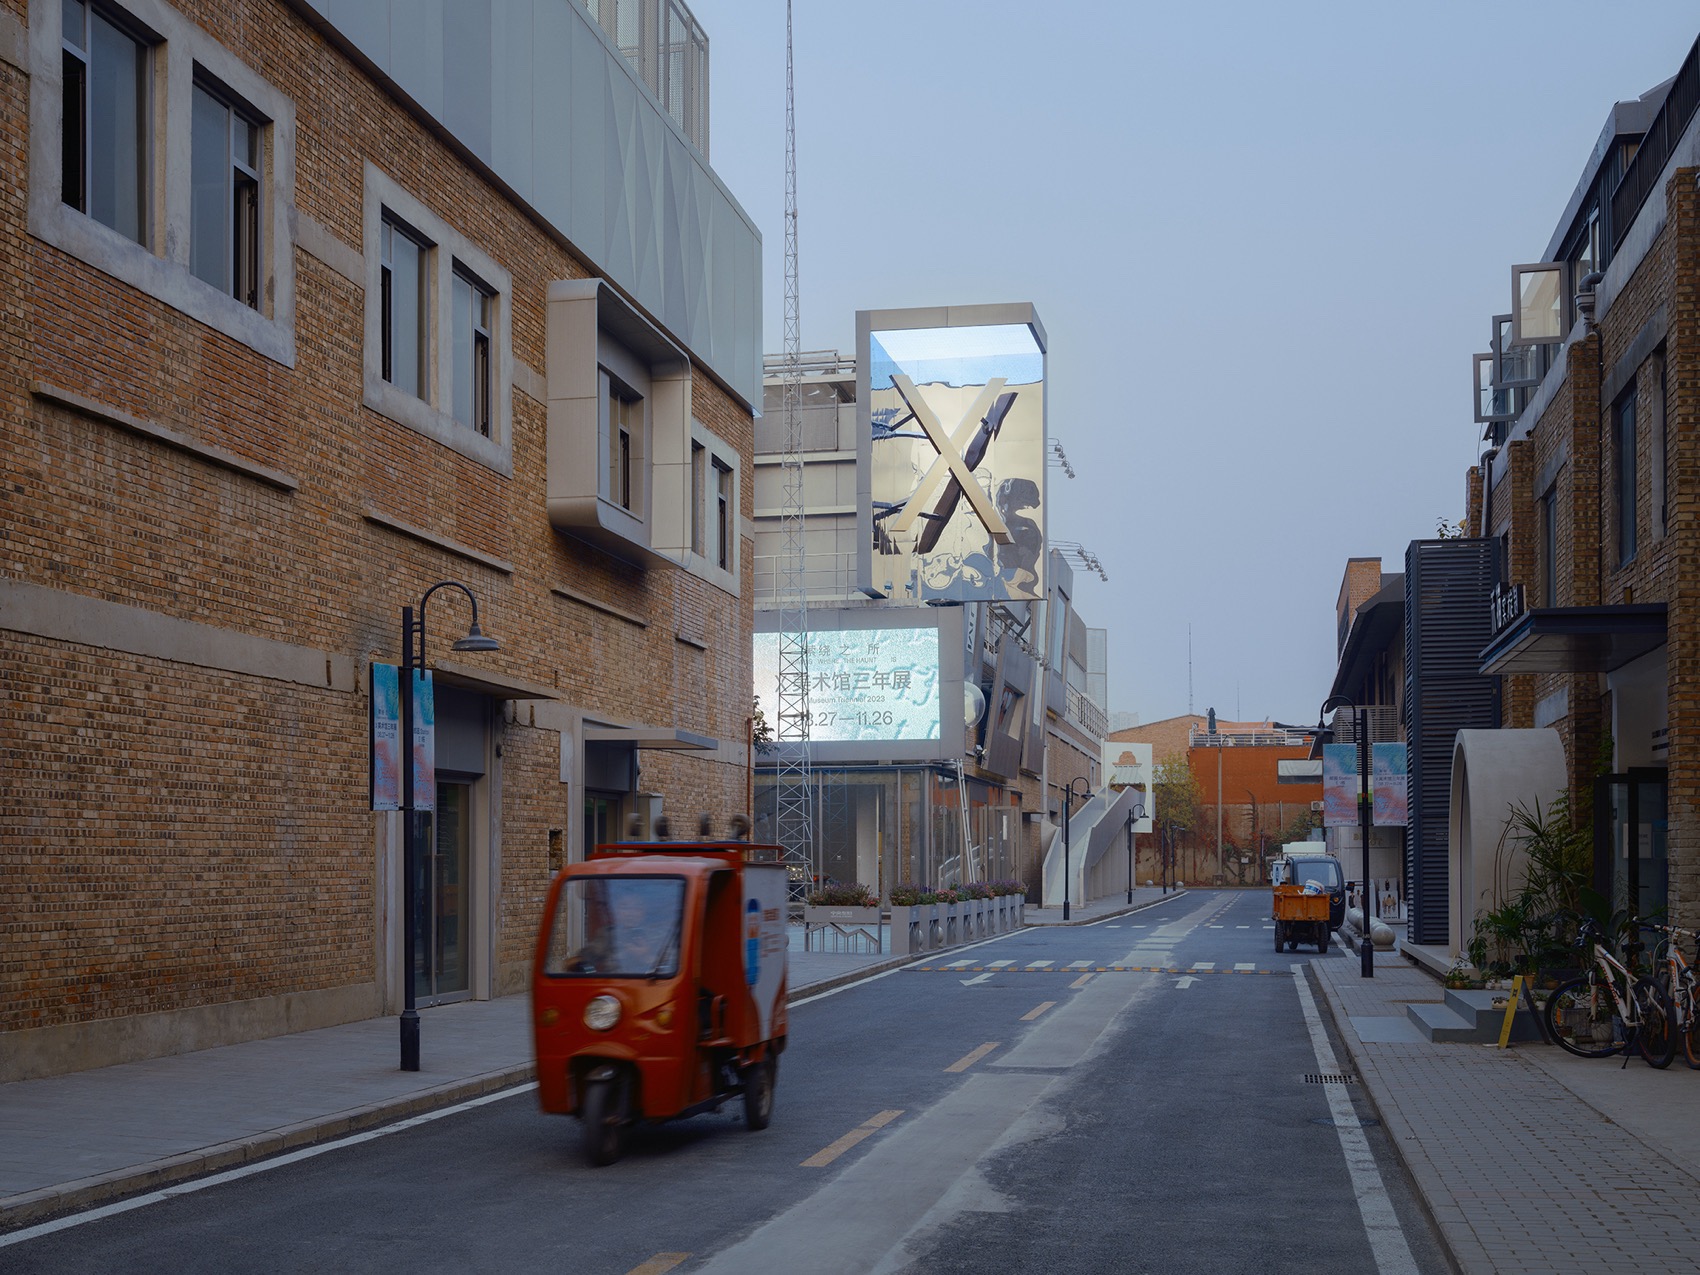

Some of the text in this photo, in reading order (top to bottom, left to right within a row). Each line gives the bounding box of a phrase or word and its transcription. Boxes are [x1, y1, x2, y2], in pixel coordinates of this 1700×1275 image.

[839, 643, 851, 656] 之
[867, 642, 880, 655] 所
[866, 695, 886, 703] 2023
